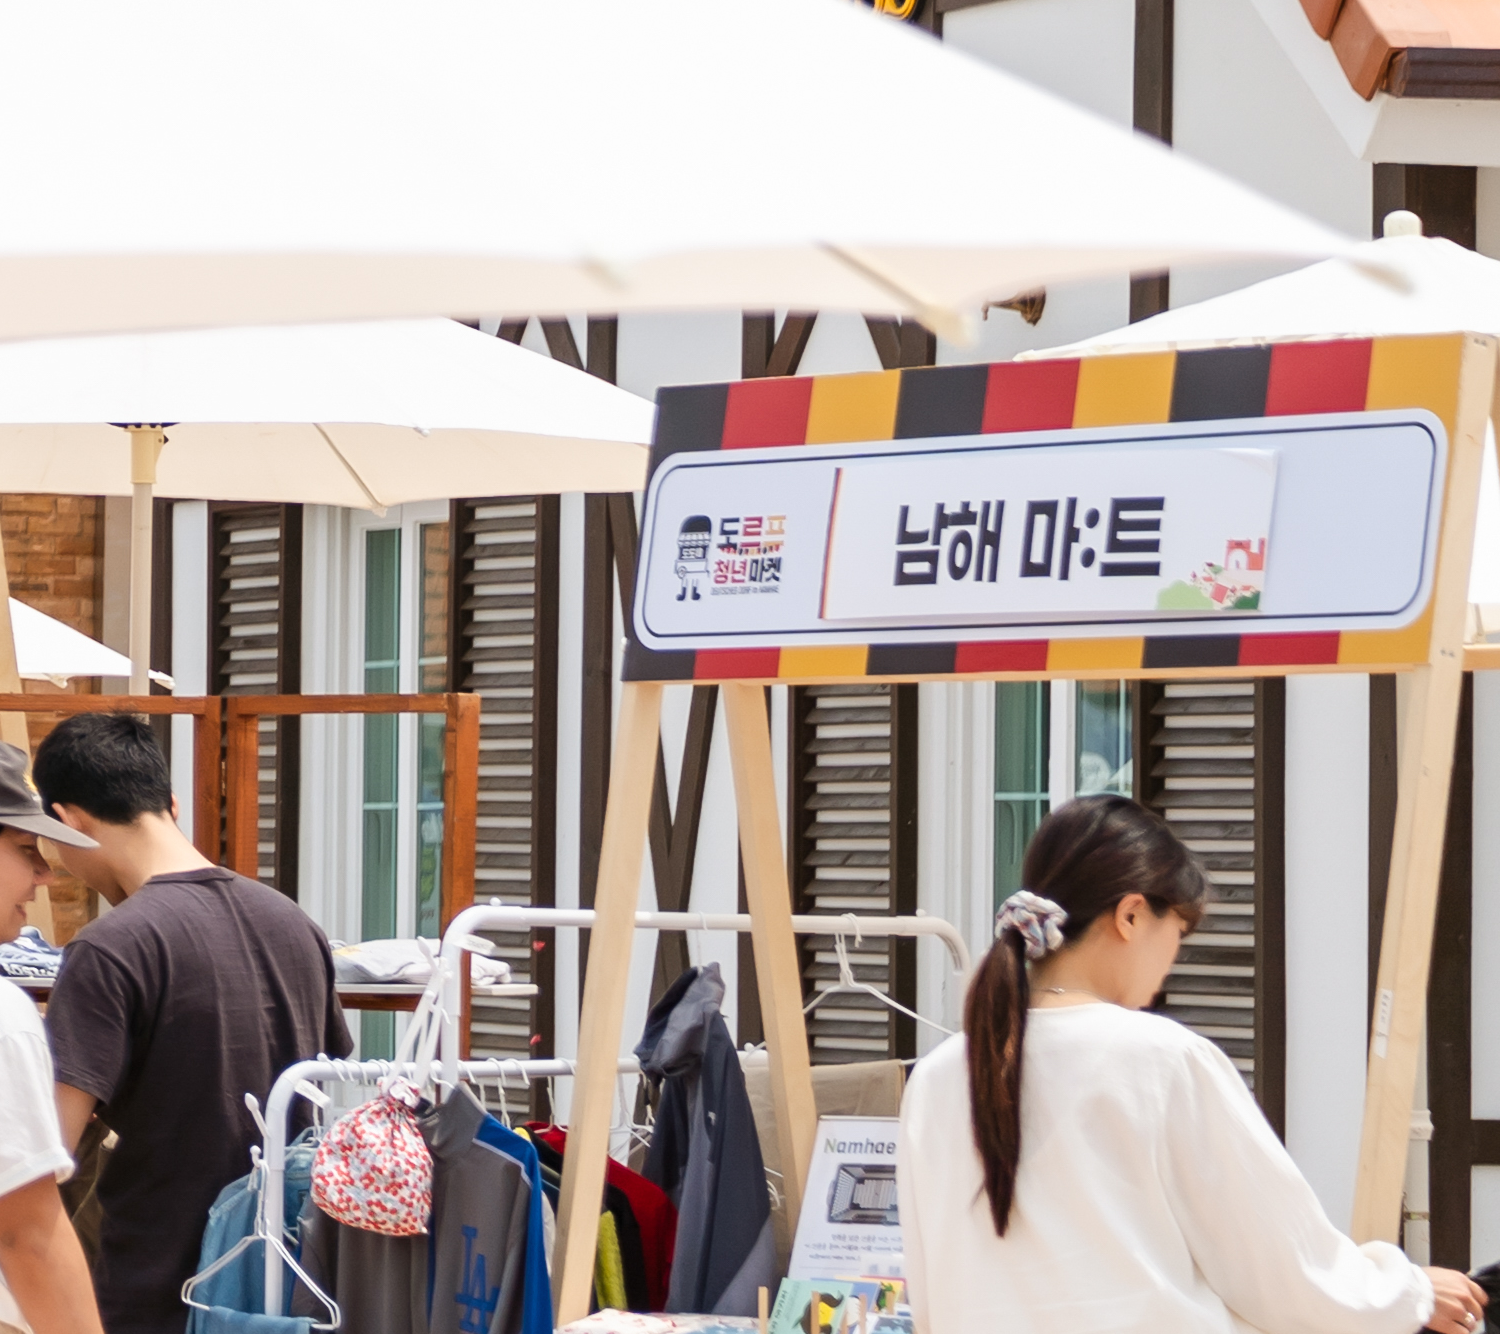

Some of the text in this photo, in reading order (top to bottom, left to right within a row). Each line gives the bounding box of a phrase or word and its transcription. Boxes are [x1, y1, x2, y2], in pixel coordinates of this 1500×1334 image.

[717, 515, 786, 555] 도르프
[893, 496, 1165, 586] 남해 마:트
[713, 556, 782, 584] 청년마켓
[823, 1137, 897, 1155] Namhae
